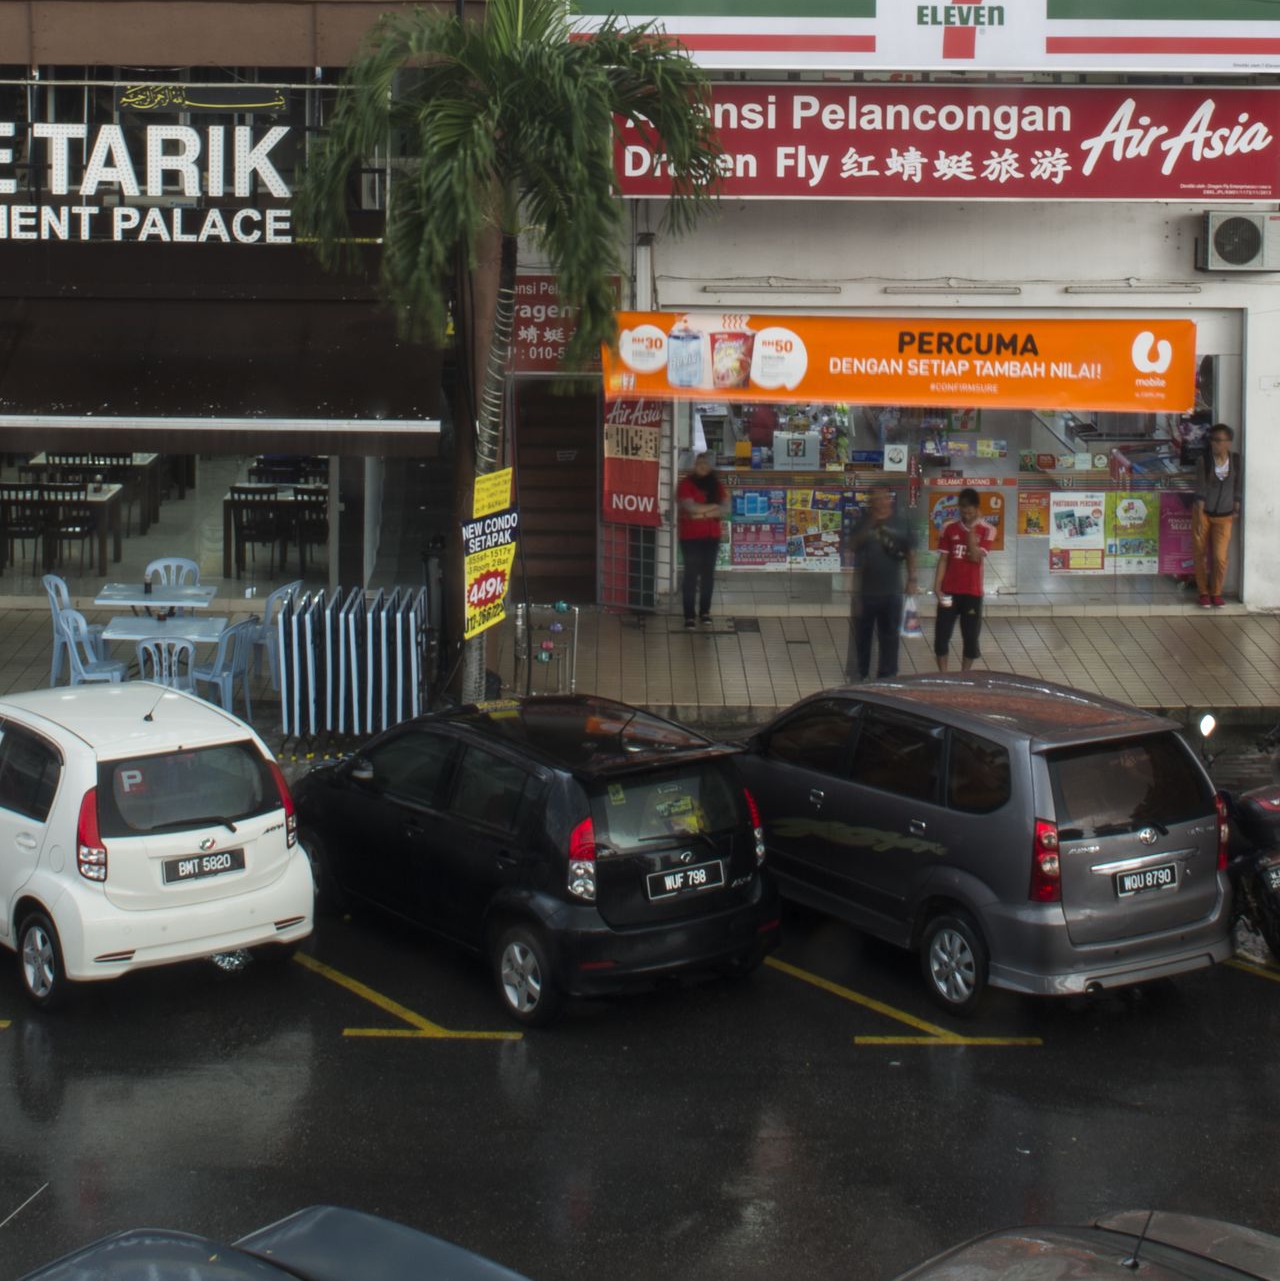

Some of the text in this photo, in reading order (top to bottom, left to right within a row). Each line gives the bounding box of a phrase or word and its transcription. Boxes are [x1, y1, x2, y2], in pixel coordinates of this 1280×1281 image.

[625, 95, 1071, 140] nsi Pelancongan
[33, 123, 293, 198] TARIK
[776, 146, 829, 186] Fly
[839, 147, 1073, 185] 红蜻蜓旅游
[113, 207, 293, 243] PALACE
[645, 337, 663, 350] 30
[775, 340, 793, 353] 50
[898, 331, 1039, 357] PERCUMA
[829, 357, 1102, 380] DENGAN SETIAP TAMBAH NILAI!
[612, 493, 655, 512] NOW
[462, 512, 518, 541] NEW CONDO
[469, 529, 512, 554] SETAPAK
[121, 770, 143, 793] P
[178, 854, 231, 877] BMT 5820
[664, 869, 706, 890] WUF 798
[1123, 868, 1171, 890] WQU 8790
